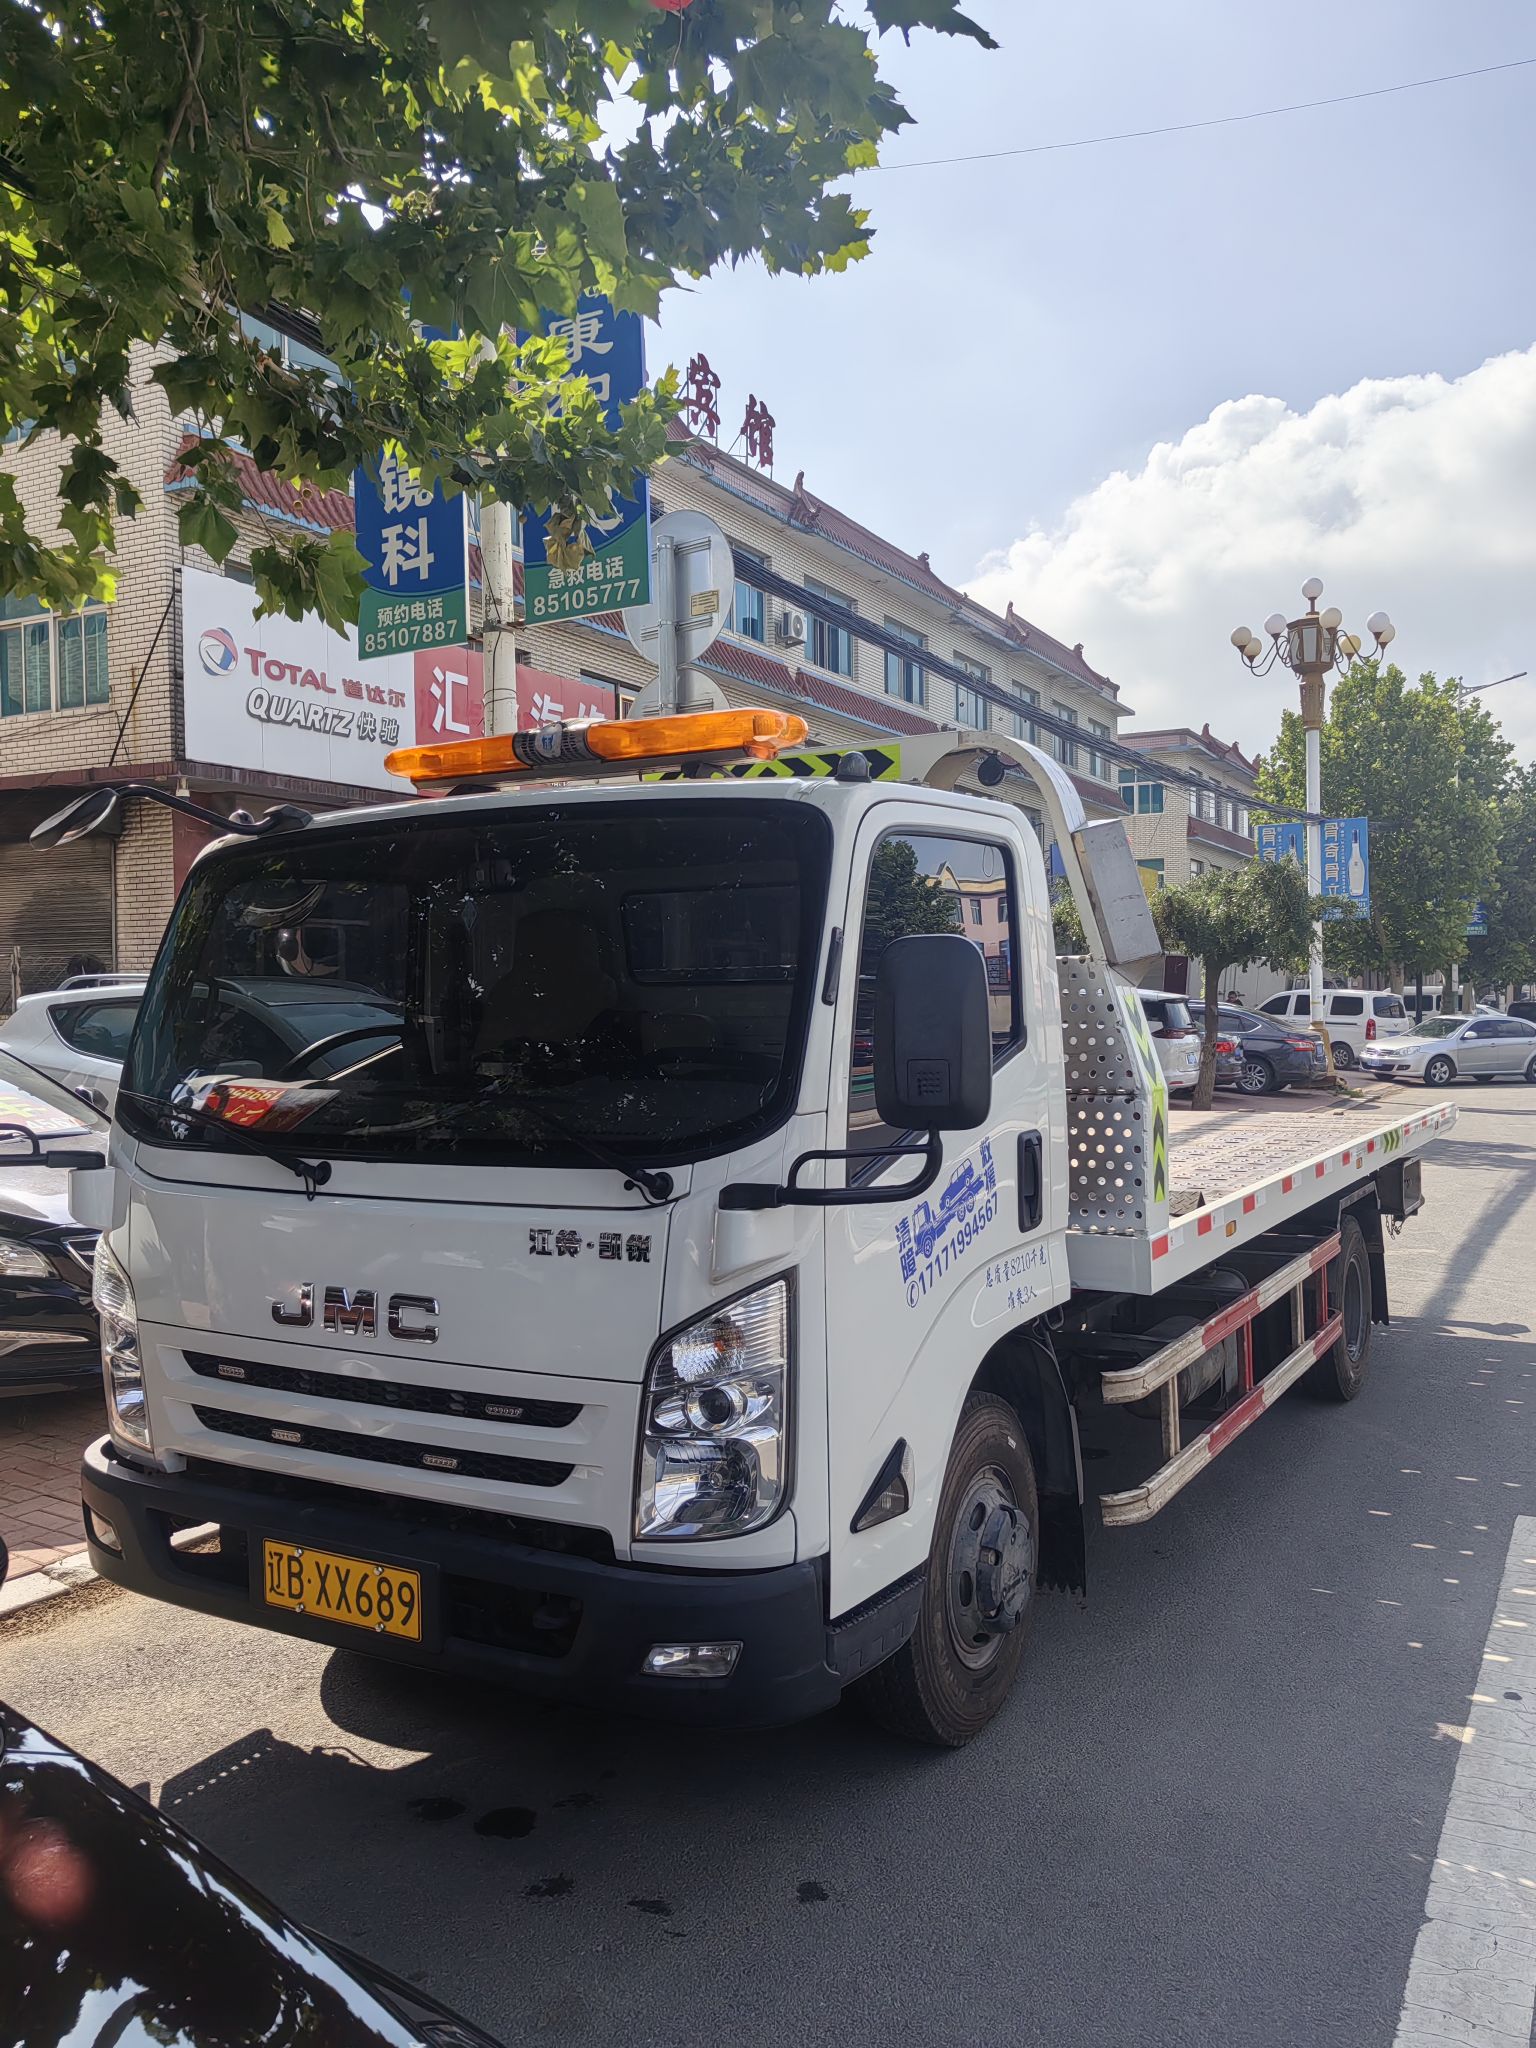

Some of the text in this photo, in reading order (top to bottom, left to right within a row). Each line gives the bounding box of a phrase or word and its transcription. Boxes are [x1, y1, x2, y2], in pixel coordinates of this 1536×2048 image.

[547, 556, 625, 590] 急救电话
[376, 598, 443, 628] 预约电话
[533, 579, 641, 616] 85105777
[364, 618, 458, 654] 85107887
[244, 647, 406, 708] TOTAL 道达尔
[246, 687, 399, 746] QUARTZ 快驰
[918, 1191, 998, 1295] 17171994567
[271, 1281, 440, 1345] JMC
